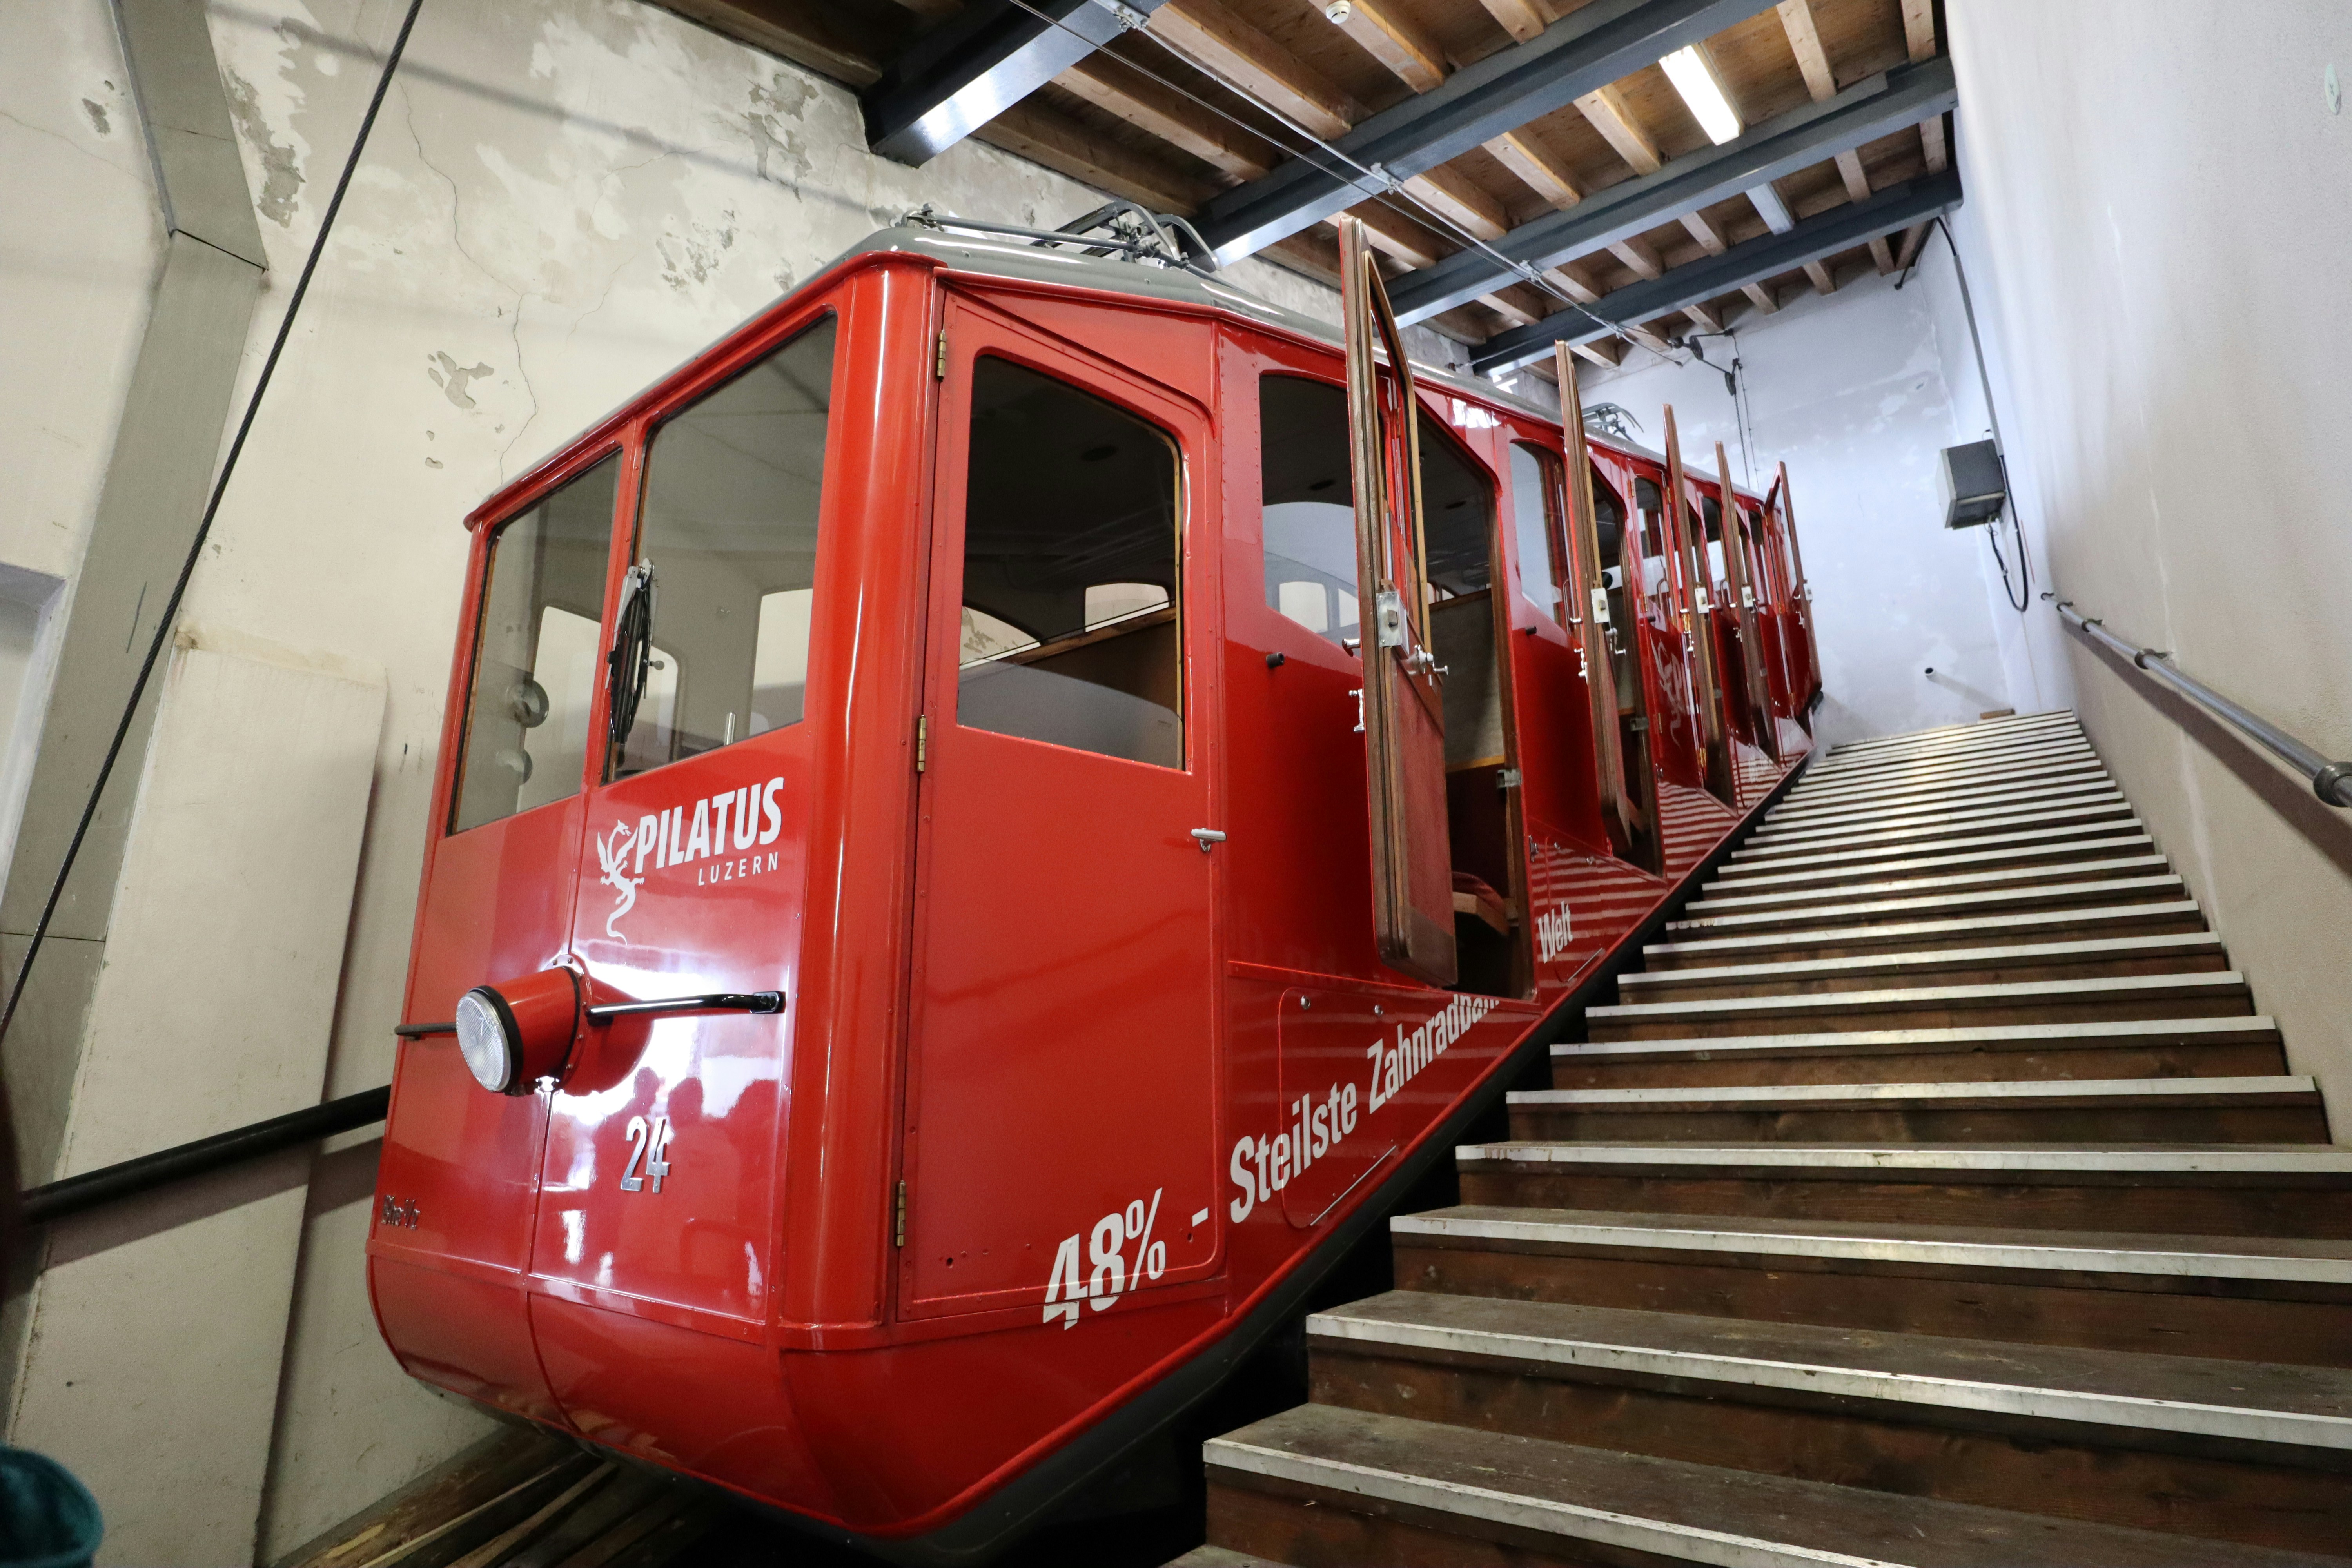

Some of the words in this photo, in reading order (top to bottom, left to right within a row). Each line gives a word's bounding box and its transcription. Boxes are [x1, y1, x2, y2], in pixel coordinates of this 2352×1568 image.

[635, 777, 784, 874] PILATUS
[698, 851, 779, 886] LUZERN
[621, 1116, 671, 1193] 24
[1043, 1187, 1166, 1330] 48%
[1230, 1082, 1357, 1223] Steilste
[1538, 900, 1573, 964] Welt
